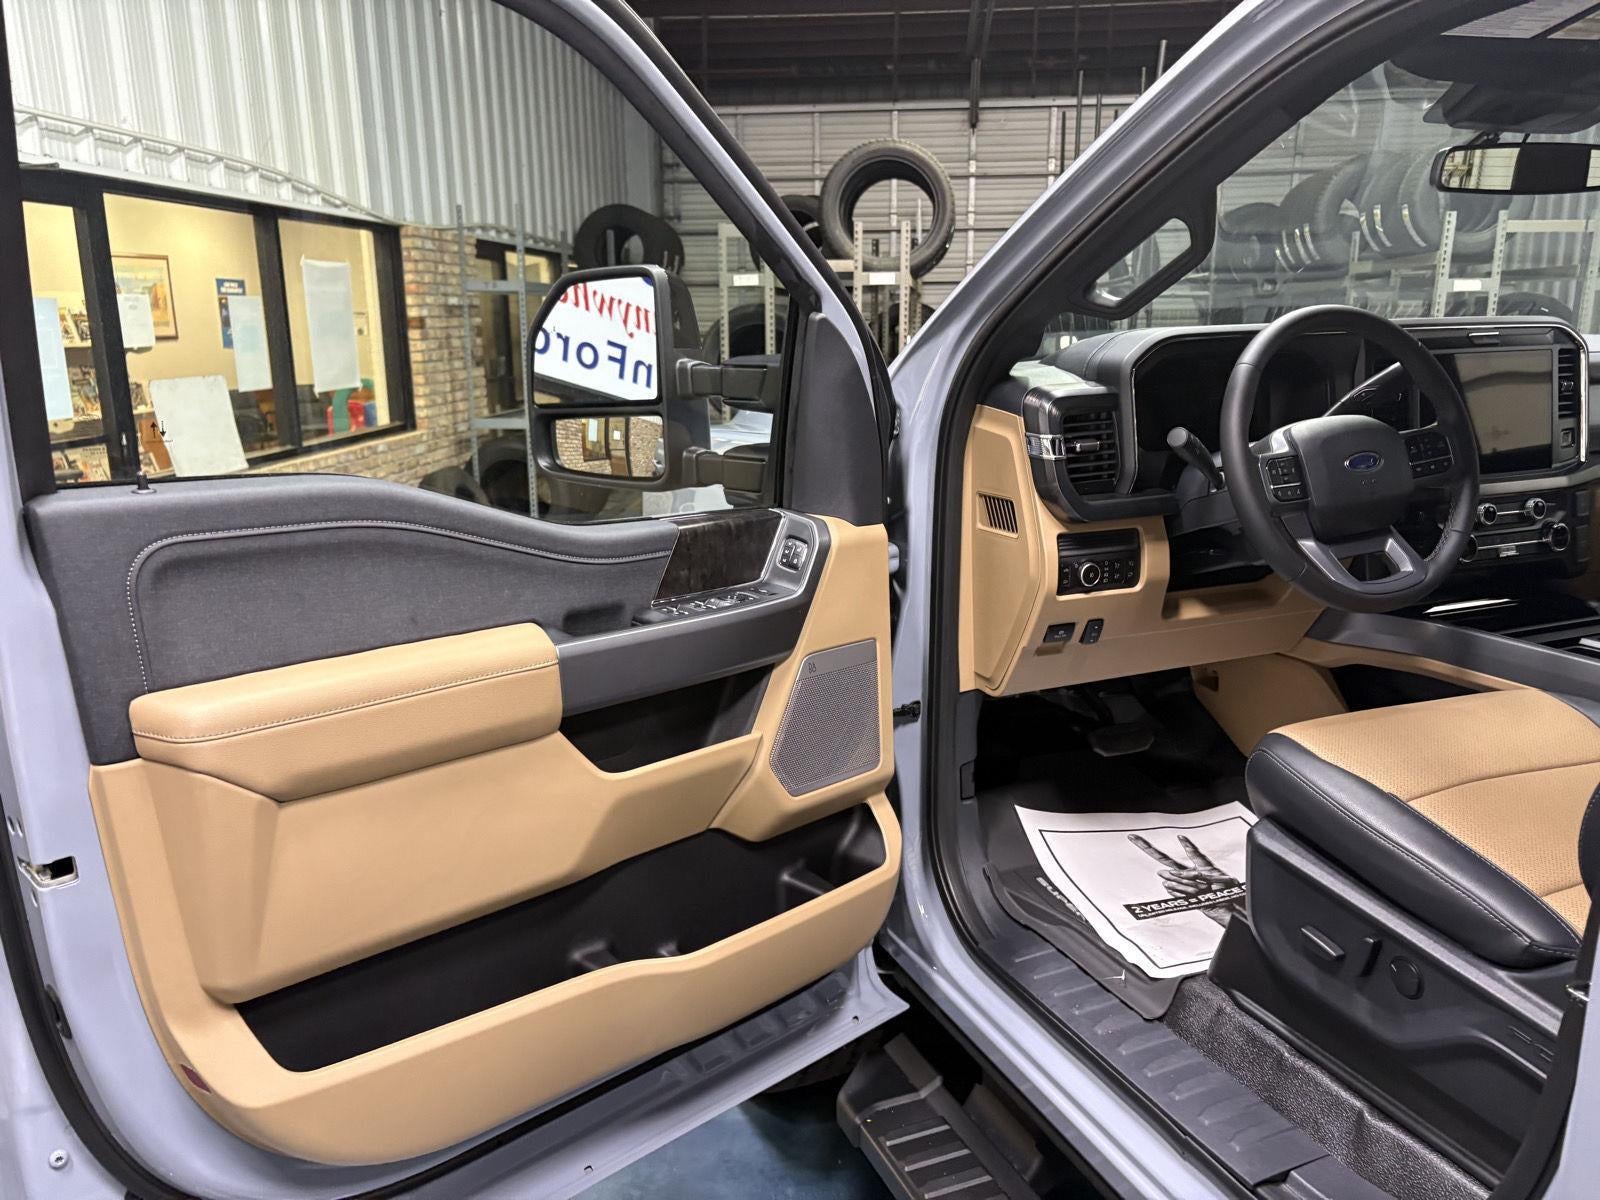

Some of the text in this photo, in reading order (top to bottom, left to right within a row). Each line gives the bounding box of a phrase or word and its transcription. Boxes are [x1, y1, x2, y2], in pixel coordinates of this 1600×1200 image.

[1131, 905, 1143, 913] 2
[1141, 899, 1189, 913] YEARS
[1197, 887, 1240, 902] PEACE
